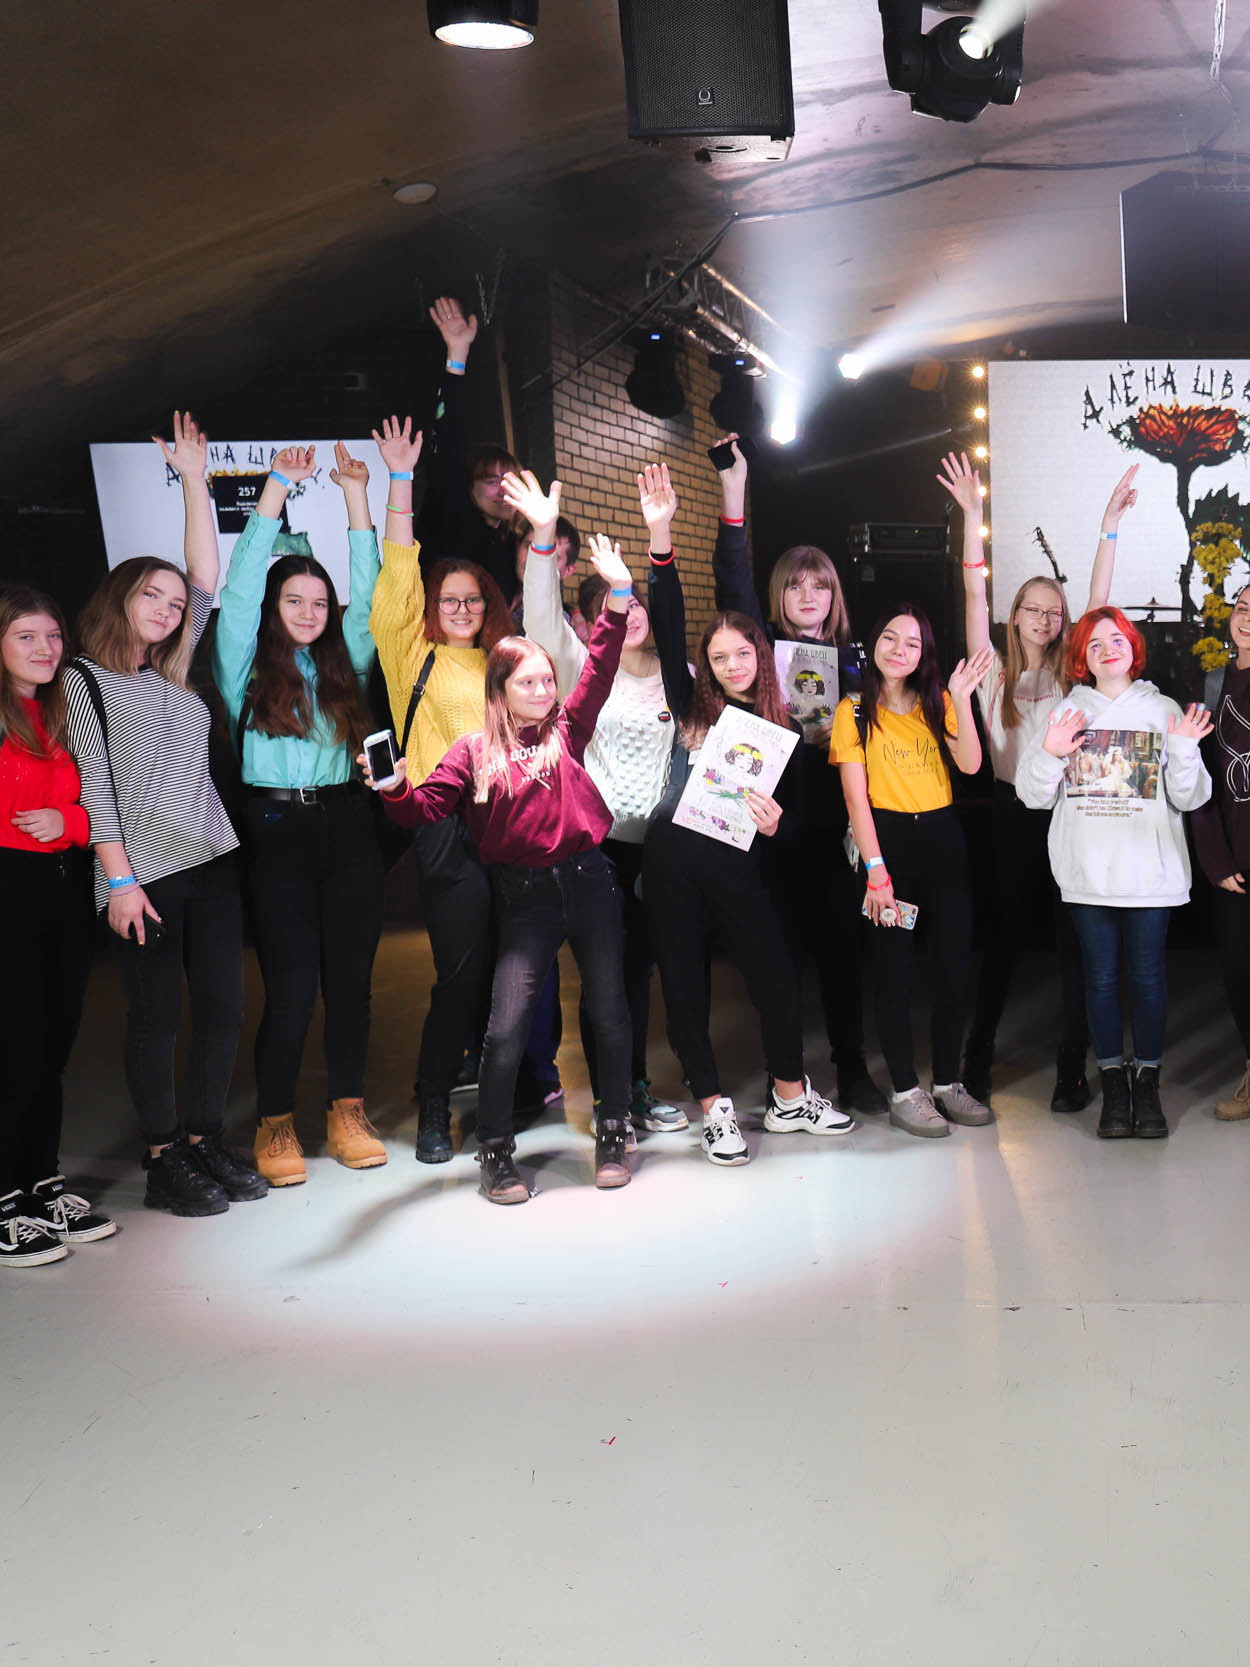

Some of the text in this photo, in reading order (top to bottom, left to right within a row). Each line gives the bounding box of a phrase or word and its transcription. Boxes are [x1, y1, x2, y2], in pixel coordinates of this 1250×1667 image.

[1081, 361, 1177, 430] АЛЁНА
[238, 487, 256, 496] 257
[916, 737, 939, 767] Yor
